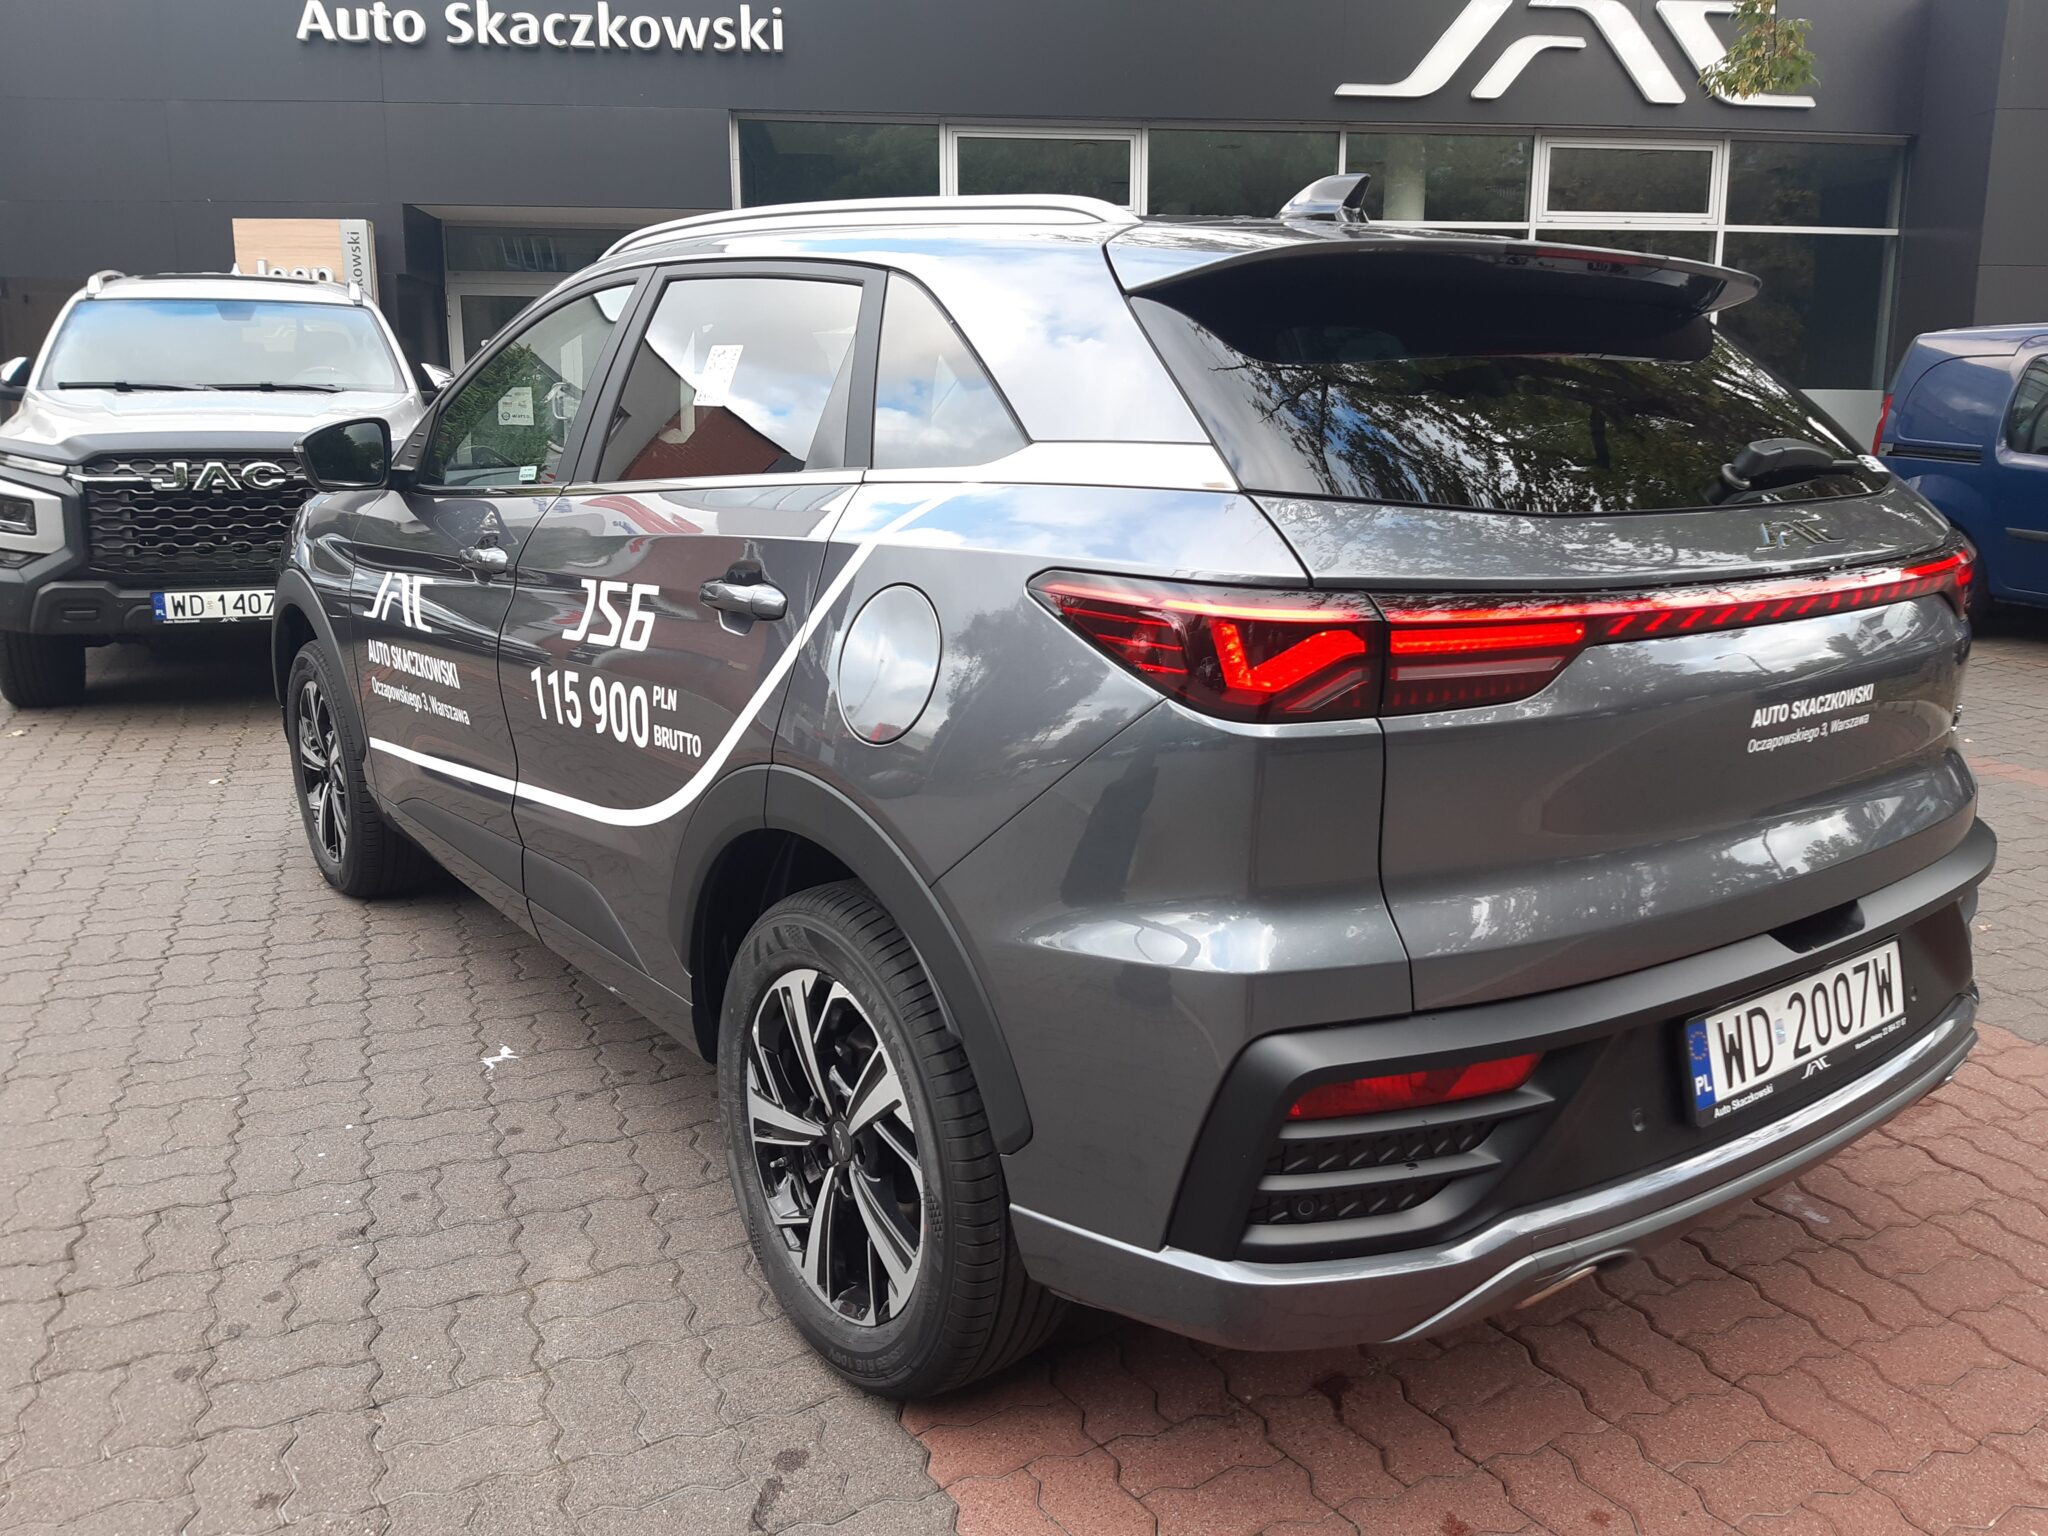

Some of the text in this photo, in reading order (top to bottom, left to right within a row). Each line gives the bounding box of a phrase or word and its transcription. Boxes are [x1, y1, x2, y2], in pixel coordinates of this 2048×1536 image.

[295, 0, 784, 53] Auto Skaczkowski
[150, 460, 286, 491] JAC
[155, 608, 166, 617] PL
[171, 594, 205, 618] WD
[561, 578, 660, 652] JS6
[367, 638, 461, 690] AUTO SKACZKOWSKI
[371, 675, 423, 713] Oczapowskiego
[428, 694, 471, 726] Warszawa
[530, 665, 678, 749] 115 900 PLN
[1750, 683, 1875, 729] AUTO SKACZKOWSKI
[653, 723, 702, 758] BRUTTO
[1747, 726, 1820, 753] Oczapowskiego
[1829, 713, 1870, 734] Warszawa
[1716, 951, 1895, 1090] WD 2007W
[1694, 1073, 1713, 1096] PL
[1713, 1104, 1732, 1119] Auto
